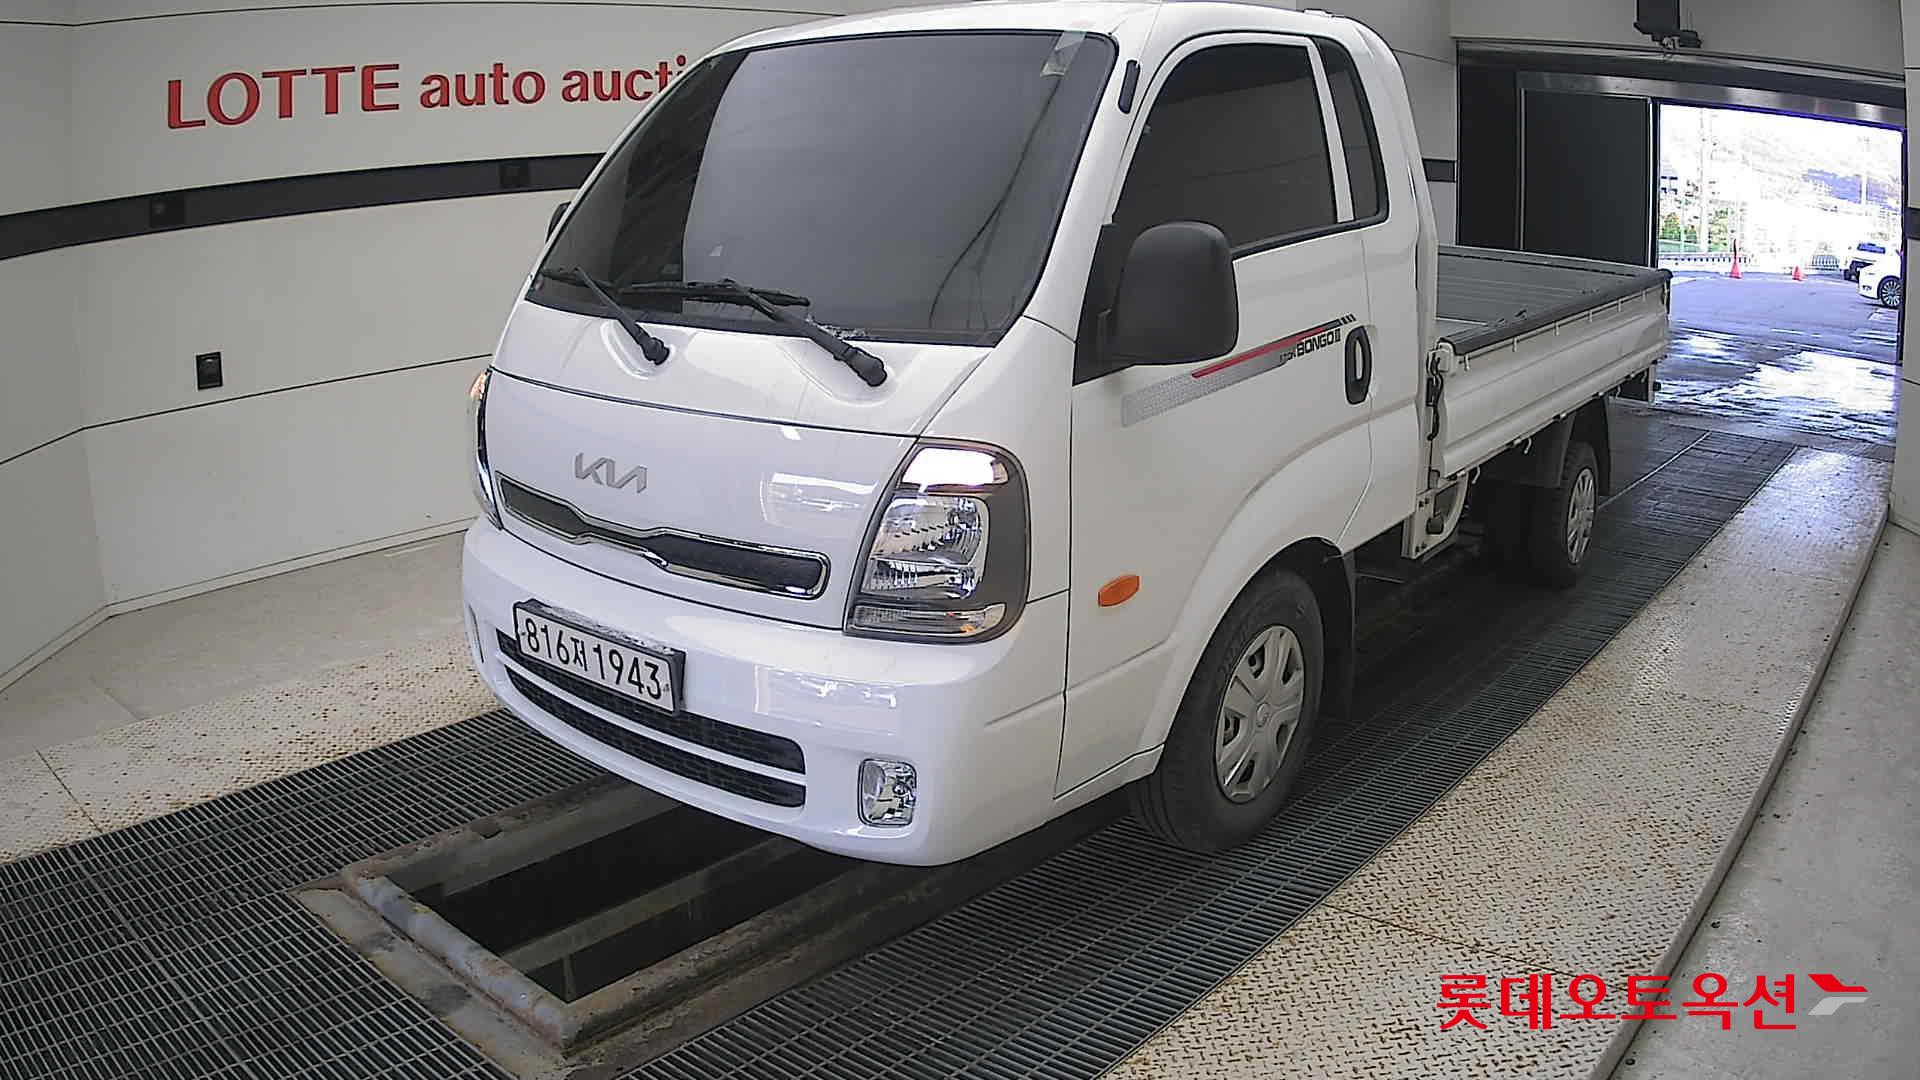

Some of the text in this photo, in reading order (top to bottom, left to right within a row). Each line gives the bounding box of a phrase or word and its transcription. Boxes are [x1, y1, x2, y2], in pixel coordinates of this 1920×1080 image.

[167, 63, 401, 130] LOTTE
[418, 62, 547, 109] auto
[574, 452, 647, 493] KIA
